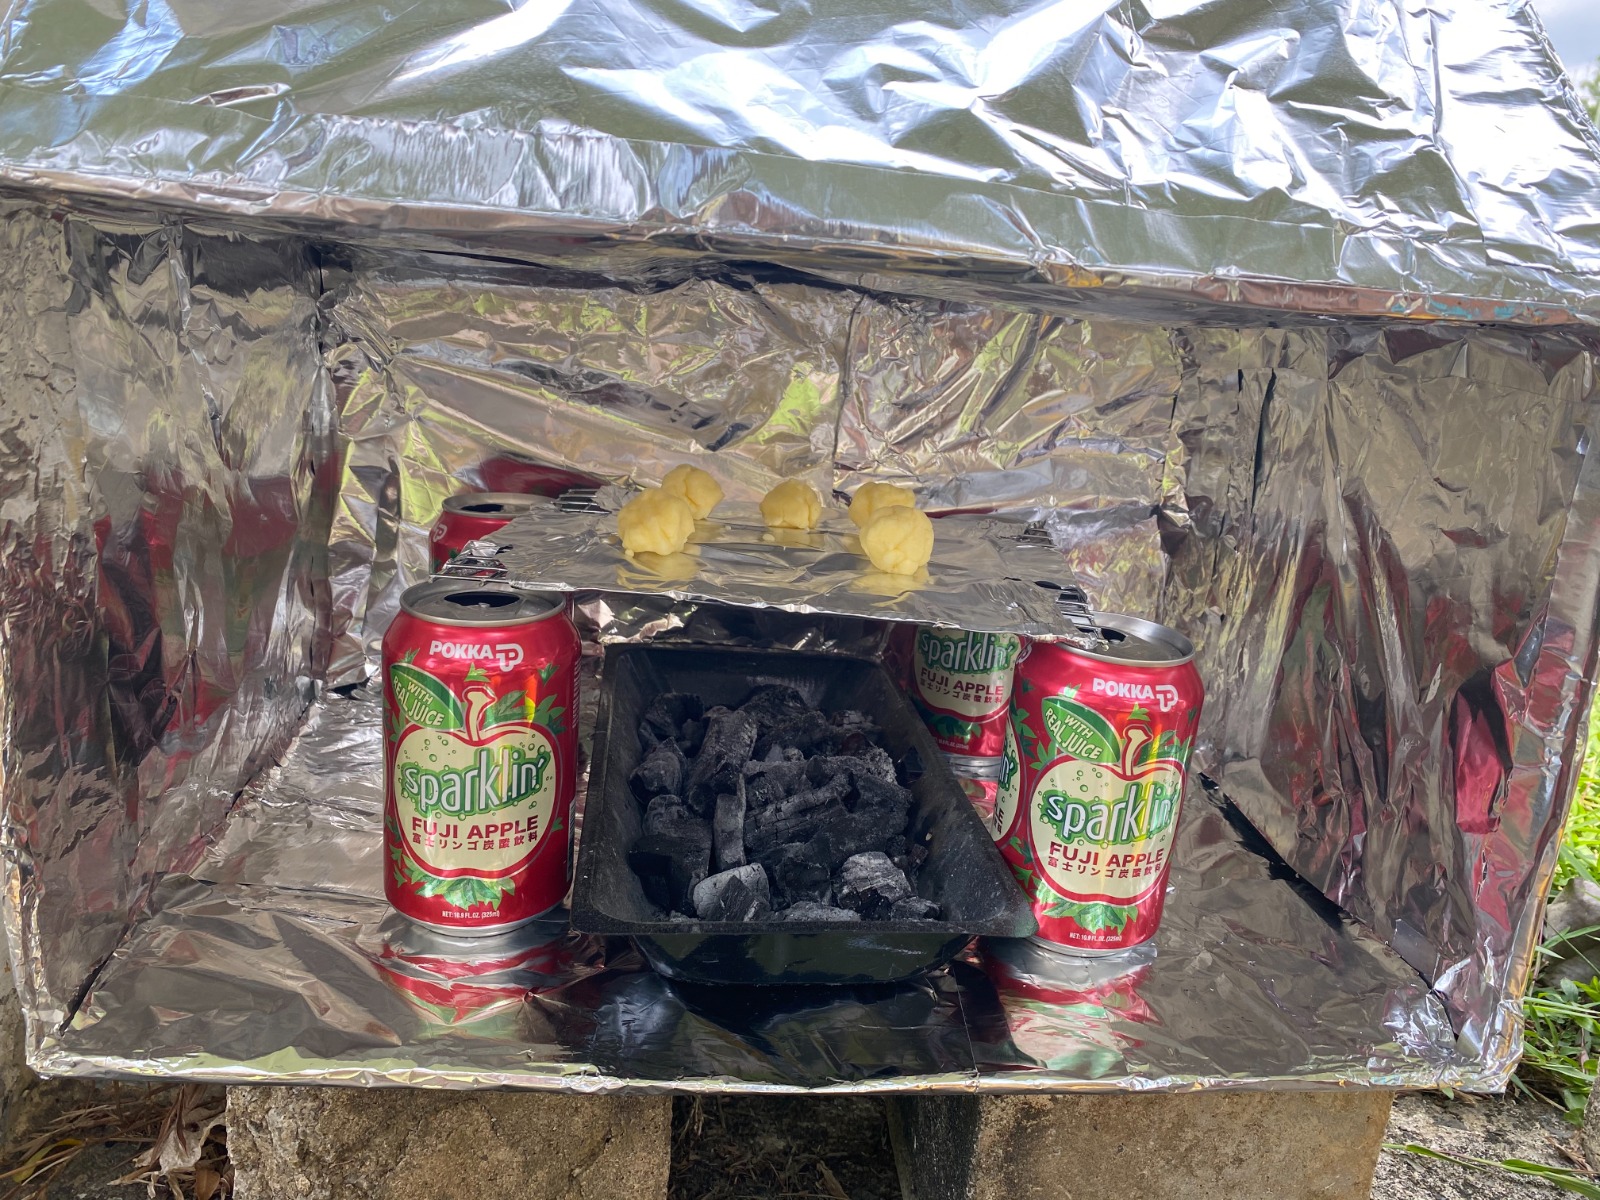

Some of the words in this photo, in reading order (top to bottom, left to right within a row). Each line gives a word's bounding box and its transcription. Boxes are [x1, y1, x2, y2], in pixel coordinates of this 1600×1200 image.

[429, 640, 495, 660] POKKA
[407, 681, 433, 705] WITH
[920, 667, 949, 687] FUJI
[953, 680, 1004, 696] APPLE
[1092, 678, 1155, 700] POKKA
[393, 676, 410, 712] REAL
[408, 701, 445, 726] JUICE
[1045, 707, 1064, 745] REAL
[1062, 734, 1103, 760] JUICE
[1064, 714, 1094, 739] WITH
[412, 816, 458, 839] FUJI
[467, 815, 539, 840] APPLE
[412, 831, 538, 851] 富士リンゴ炭酸飲料
[1049, 841, 1099, 866] FUJI
[1105, 848, 1165, 868] APPLE
